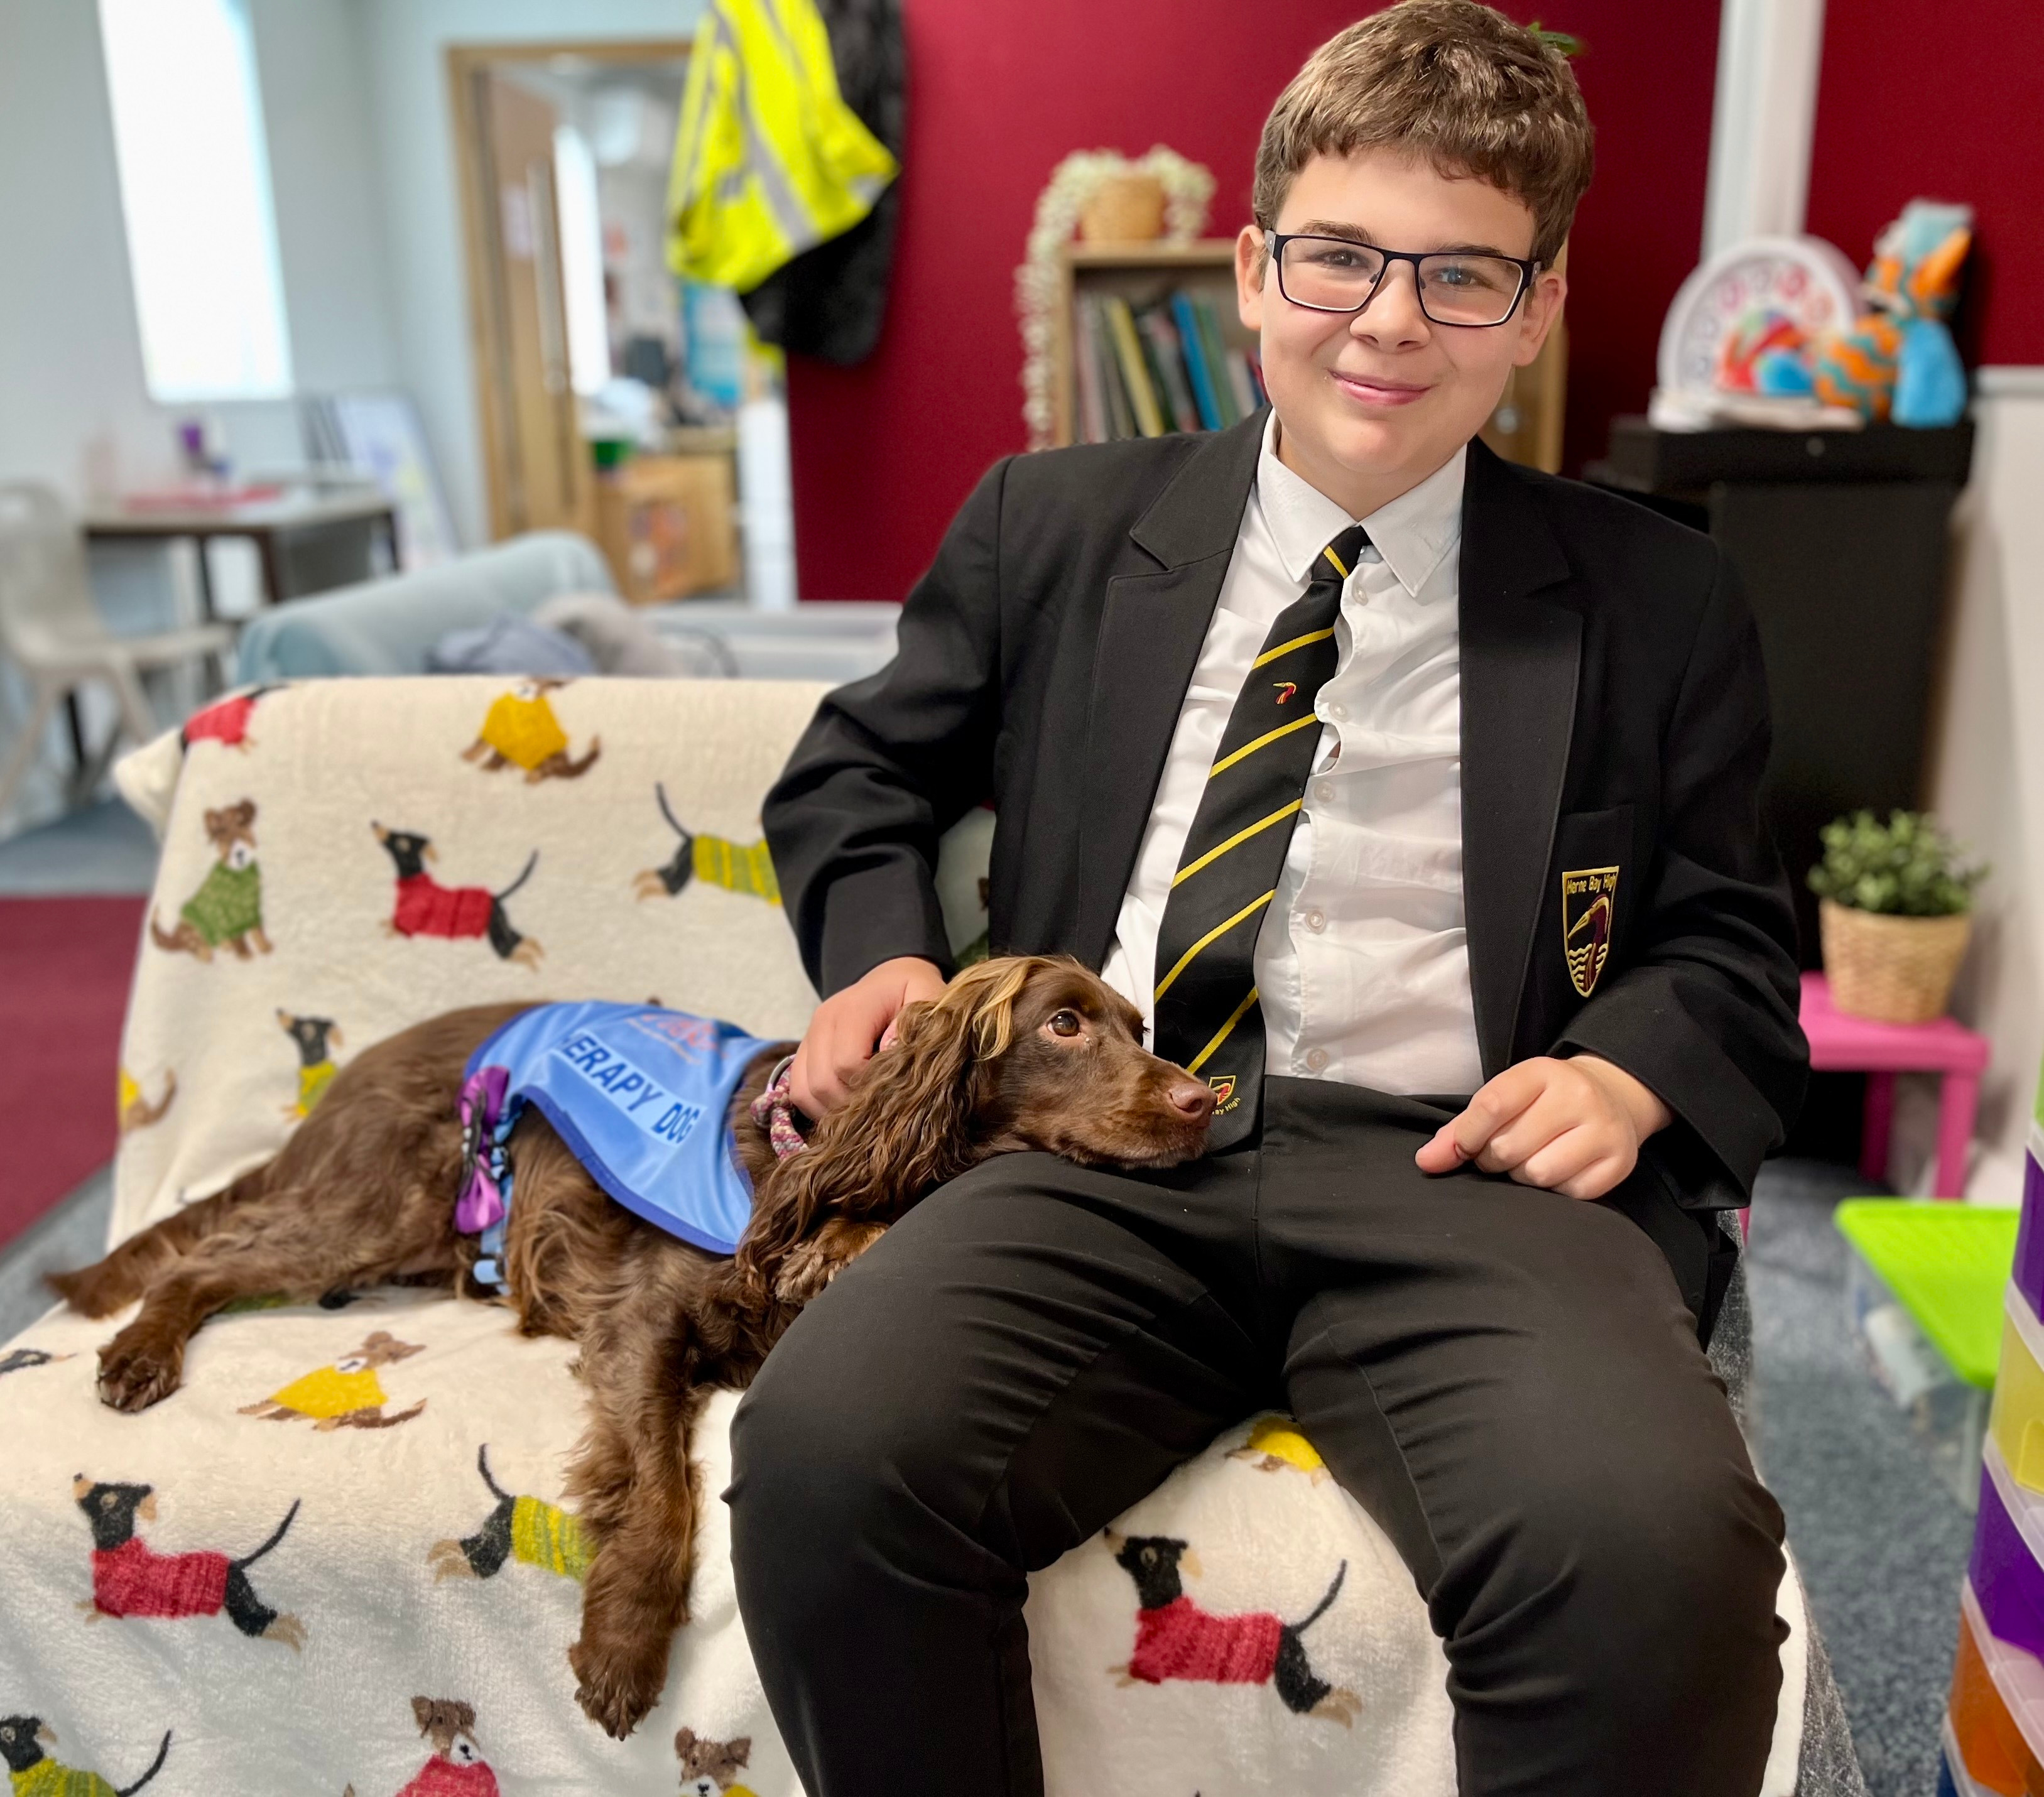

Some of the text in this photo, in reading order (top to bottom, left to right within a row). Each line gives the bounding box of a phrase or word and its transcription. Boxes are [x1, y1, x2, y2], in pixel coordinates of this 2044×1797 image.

[1588, 876, 1602, 893] Bay
[561, 1035, 665, 1112] ERAPY
[650, 1101, 700, 1144] DOG
